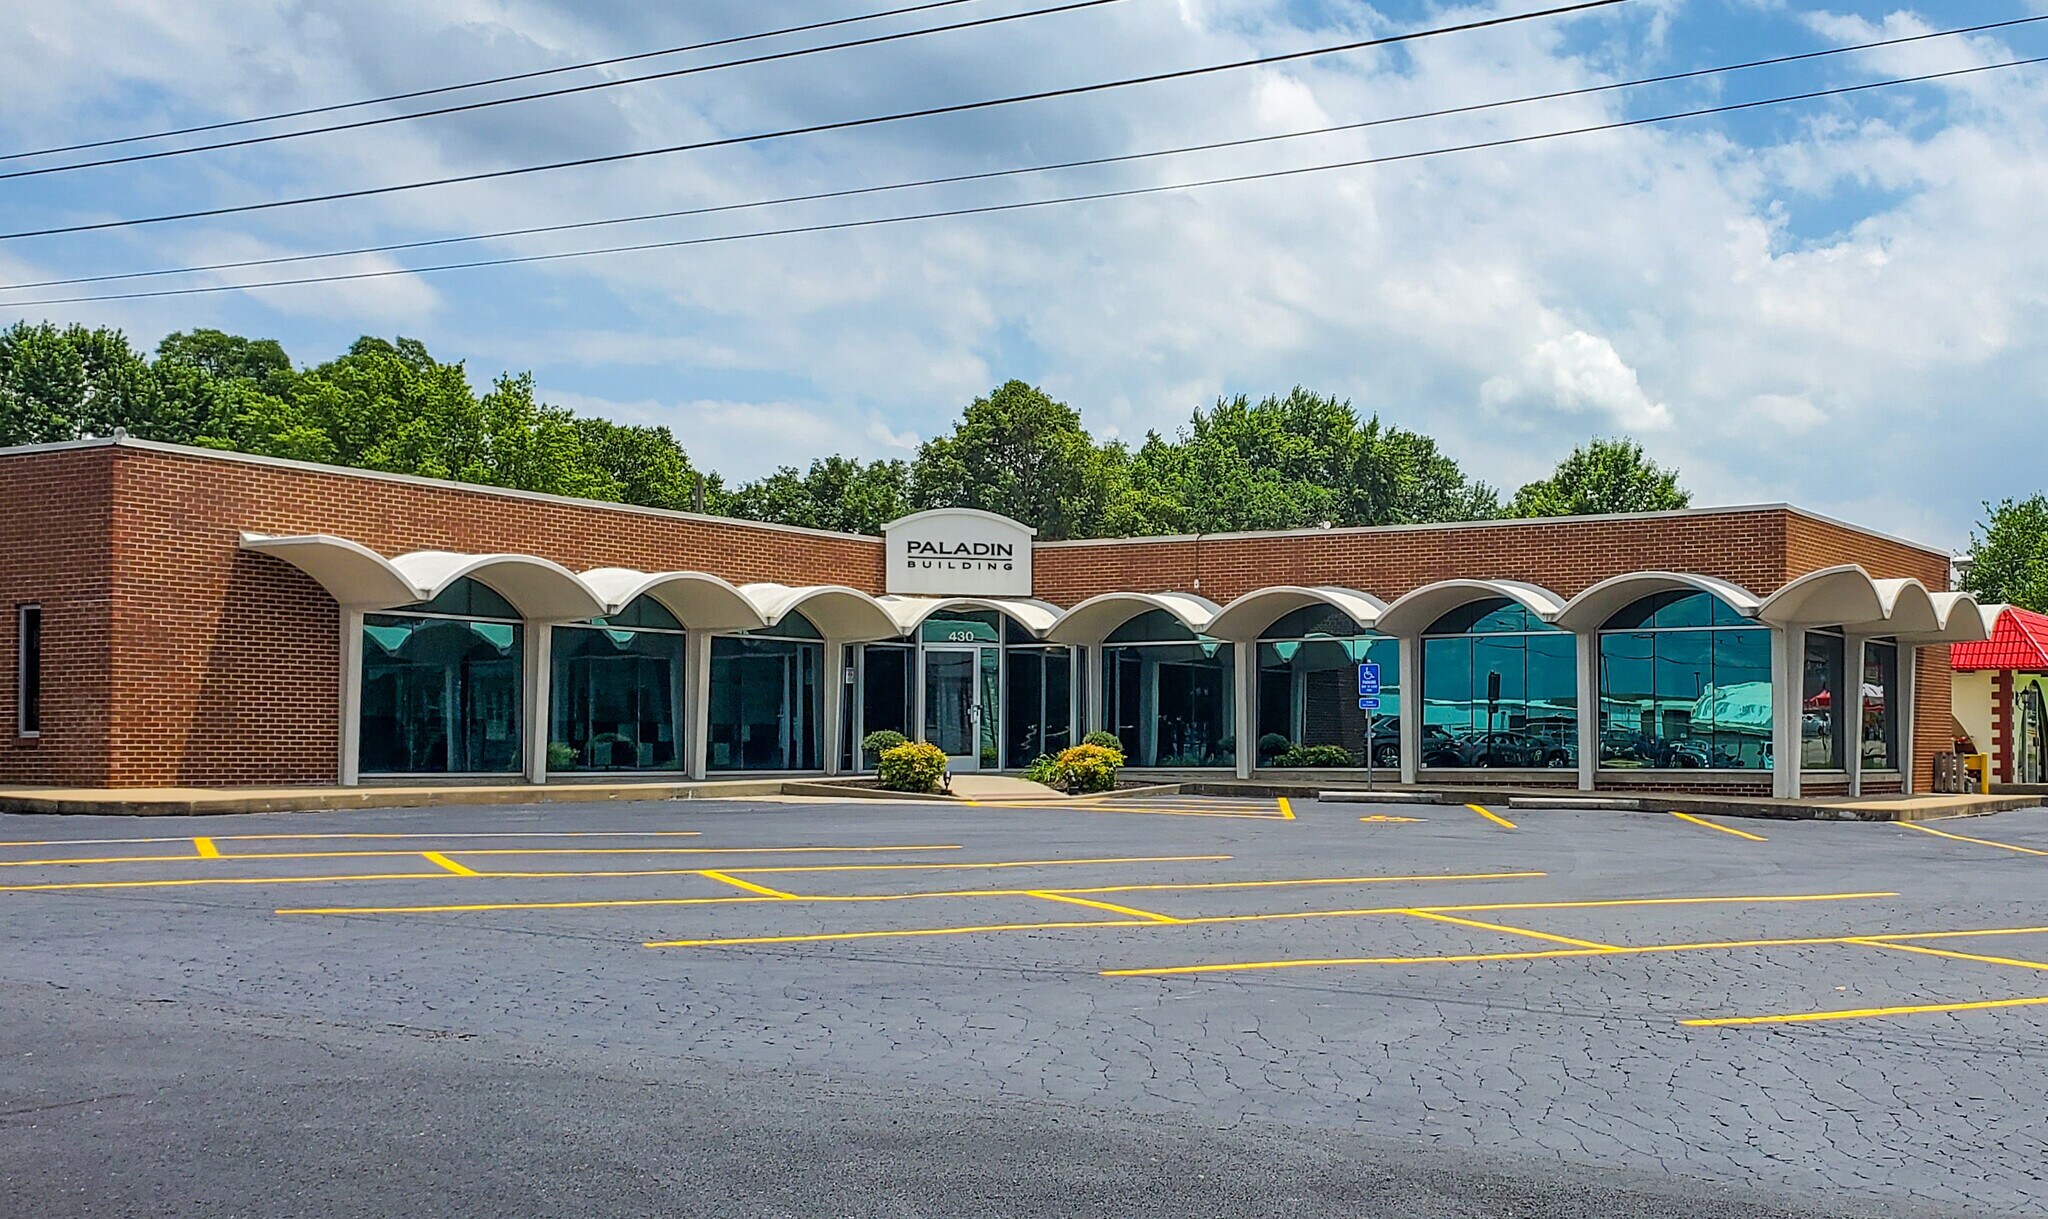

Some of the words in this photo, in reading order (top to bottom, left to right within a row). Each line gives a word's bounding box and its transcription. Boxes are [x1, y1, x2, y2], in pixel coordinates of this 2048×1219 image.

[907, 540, 1013, 556] PALADIN
[907, 560, 1013, 571] BUILDING
[948, 631, 974, 642] 430
